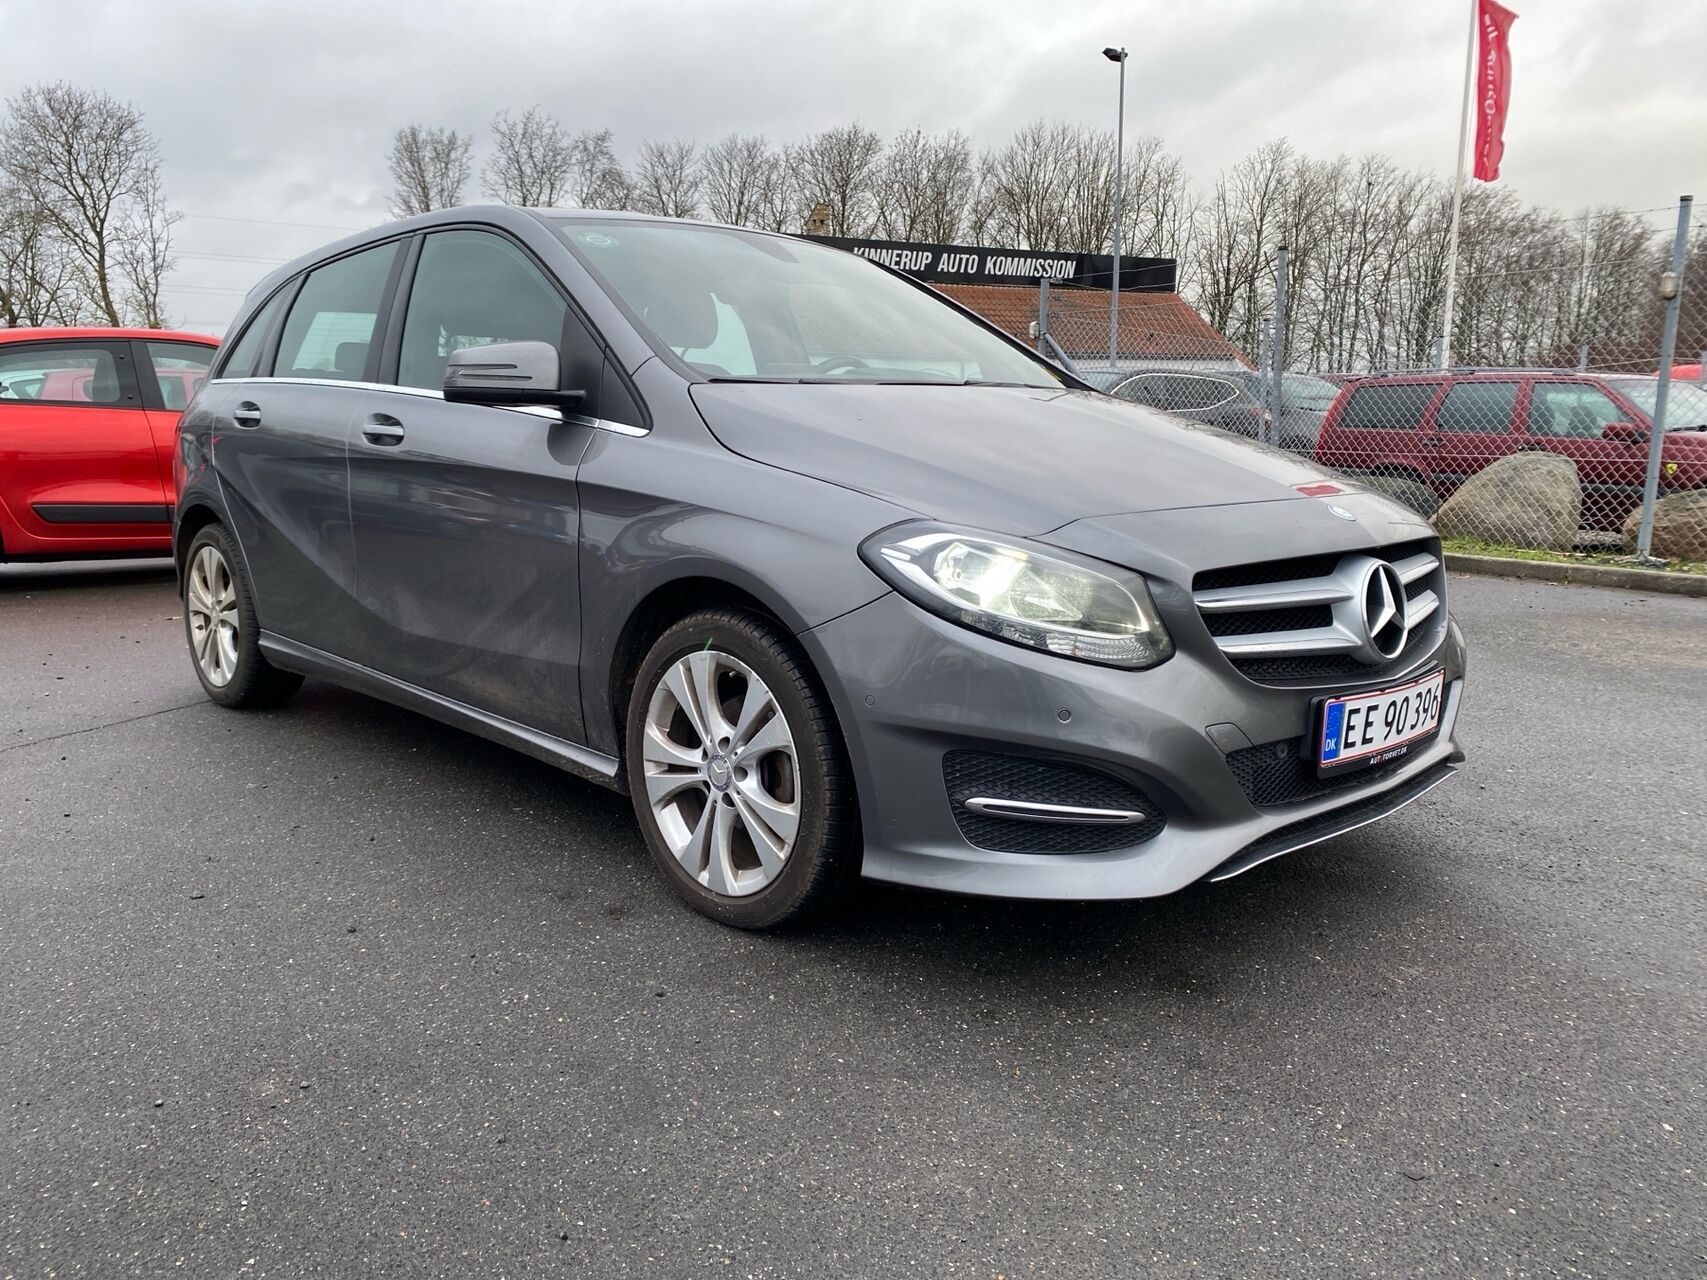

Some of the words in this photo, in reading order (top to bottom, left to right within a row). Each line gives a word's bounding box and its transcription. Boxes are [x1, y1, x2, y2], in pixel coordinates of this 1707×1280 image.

[937, 253, 979, 274] AUTO
[985, 256, 1076, 279] KOMMISSION
[1343, 704, 1380, 750] EE
[1384, 695, 1410, 741] 90
[1410, 683, 1440, 730] 396
[1325, 738, 1337, 752] DK
